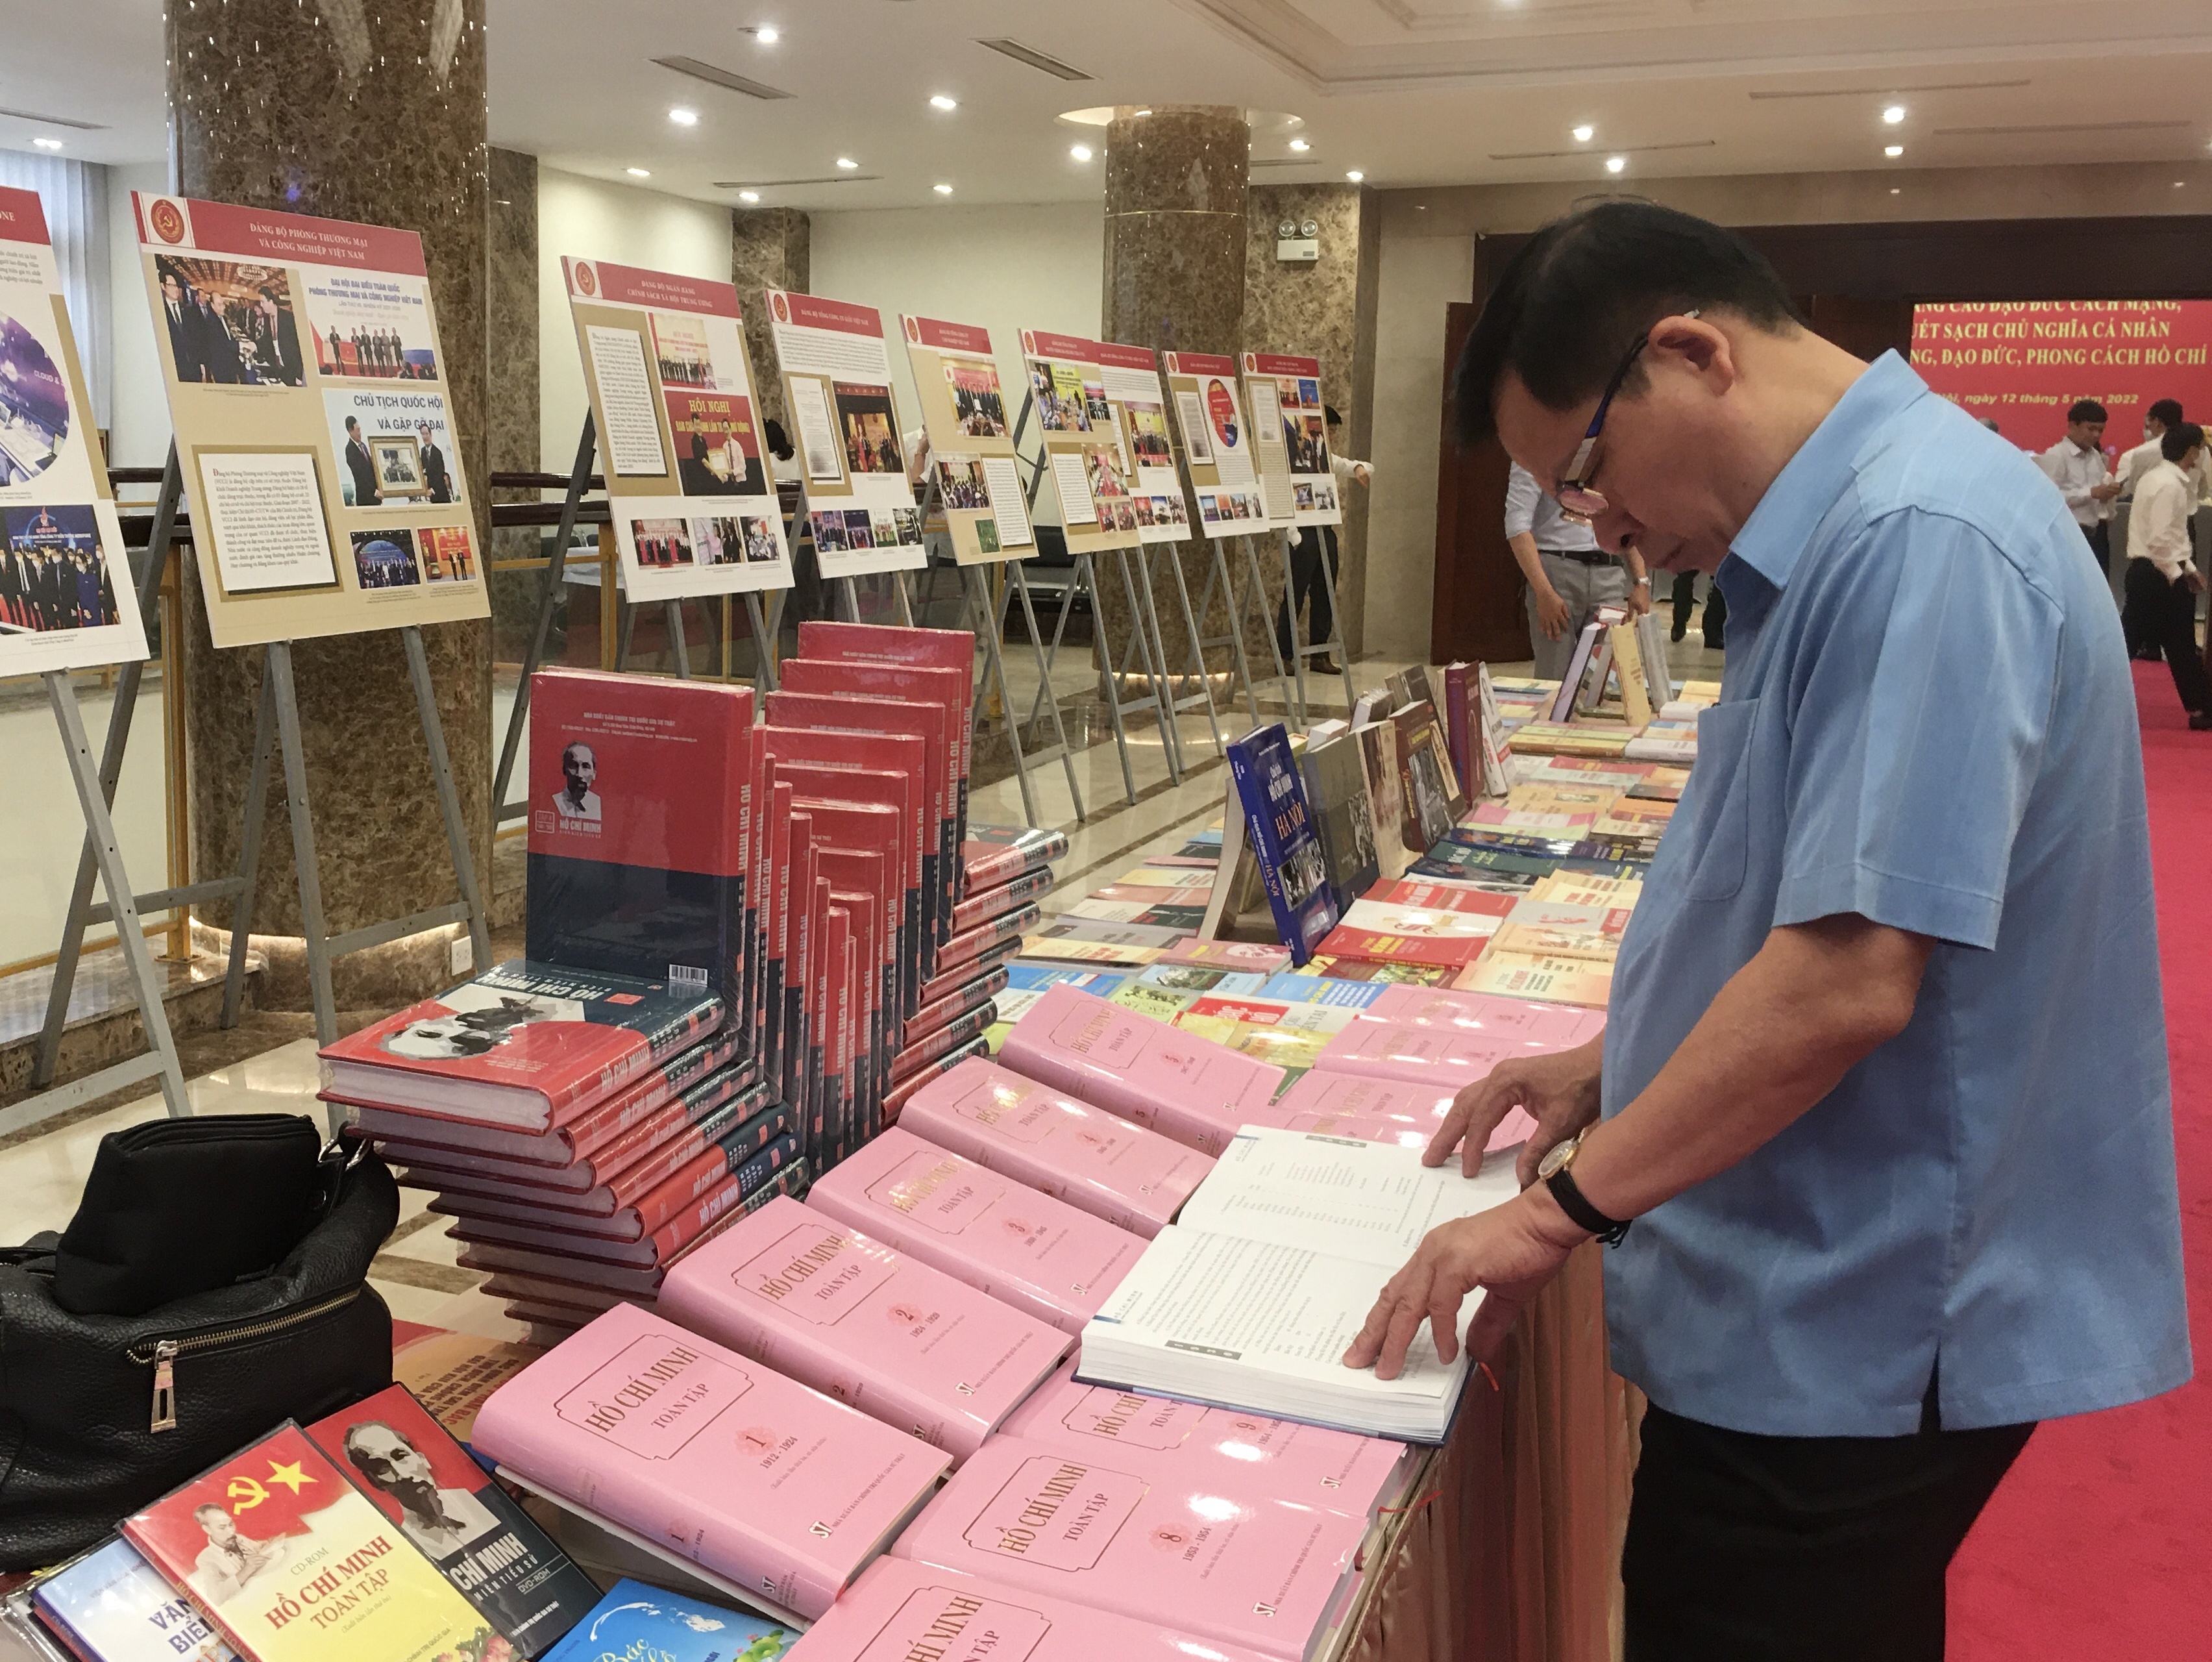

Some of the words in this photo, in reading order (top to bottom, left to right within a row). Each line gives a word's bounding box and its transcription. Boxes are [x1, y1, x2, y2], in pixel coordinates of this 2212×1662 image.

[250, 221, 273, 234] ĐẢNG
[276, 226, 287, 238] BỘ
[289, 228, 317, 240] PHÒNG
[353, 238, 368, 247] MẠI
[259, 238, 270, 247] VÀ
[272, 239, 295, 251] CÔNG
[297, 243, 326, 256] NGHIỆP
[328, 247, 345, 257] VIỆT
[348, 251, 365, 260] NAM
[1943, 323, 1988, 342] SẠCH
[1993, 318, 2028, 338] CHỦ
[2033, 318, 2088, 338] NGHĨA
[2092, 318, 2115, 338] CÁ
[2120, 317, 2170, 338] NHÂN
[1941, 349, 1977, 368] ĐẠO
[1981, 344, 2022, 367] ĐỨC,
[2026, 349, 2086, 365] PHONG
[2091, 344, 2139, 365] CÁCH
[2144, 343, 2170, 365] HỒ
[2174, 343, 2207, 365] CHÍ
[34, 370, 53, 383] CLOUD
[354, 393, 374, 406] CHỦ
[376, 396, 398, 410] TỊCH
[400, 394, 426, 408] QUỐC
[428, 395, 443, 410] HỘI
[689, 397, 706, 416] HỘI
[708, 400, 730, 416] NGHỊ
[1965, 395, 1997, 404] ngày
[2002, 394, 2017, 403] 12
[2020, 394, 2057, 405] tháng
[2061, 395, 2070, 403] 5
[2107, 395, 2138, 404] 2022
[377, 416, 391, 430] VÀ
[393, 417, 412, 432] GẶP
[429, 419, 444, 432] ĐẠI
[583, 822, 601, 833] MINH
[1275, 806, 1292, 840] HÀ
[1288, 799, 1306, 830] NỘI
[1136, 1110, 1146, 1118] 5
[699, 1199, 709, 1227] HỒ
[709, 1192, 721, 1219] CHÍ
[721, 1183, 739, 1209] MINH
[1009, 1222, 1026, 1233] 3
[758, 1274, 793, 1300] HỒ
[781, 1255, 819, 1284] CHÍ
[804, 1235, 845, 1269] MINH
[814, 1278, 846, 1300] TOÀN
[841, 1265, 862, 1285] TẬP
[895, 1309, 915, 1321] 2
[584, 1400, 626, 1433] HỒ
[614, 1374, 659, 1408] CHÍ
[641, 1346, 700, 1386] MINH
[832, 1384, 846, 1396] 2
[650, 1401, 689, 1429] TOÀN
[682, 1383, 709, 1403] TẬP
[1090, 1413, 1127, 1437] HỒ
[1111, 1391, 1148, 1418] CHÍ
[1149, 1405, 1175, 1428] TOÀN
[1236, 1421, 1257, 1432] 9
[746, 1435, 767, 1448] 1
[759, 1453, 780, 1469] 1912
[779, 1435, 798, 1451] 1924
[1038, 1464, 1088, 1503] MINH
[1018, 1497, 1059, 1527] CHÍ
[1063, 1513, 1095, 1541] TOÀN
[1085, 1493, 1109, 1513] TẬP
[808, 1520, 833, 1539] ST
[995, 1526, 1037, 1554] HỒ
[1159, 1532, 1182, 1543] 8
[1182, 1546, 1199, 1562] 1953
[1195, 1526, 1212, 1543] 1954
[290, 1547, 329, 1576] CD-ROM
[449, 1552, 488, 1591] CHÍ
[475, 1532, 528, 1574] MINH
[264, 1592, 302, 1630] HỒ
[299, 1566, 343, 1604] CHÍ
[335, 1535, 393, 1581] MINH
[474, 1580, 501, 1602] NIÊN
[518, 1569, 550, 1593] DVD-ROM
[310, 1589, 360, 1630] TOÀN
[356, 1569, 391, 1596] TẬP
[1251, 1601, 1278, 1618] ST
[923, 1596, 984, 1645] MINH
[972, 1630, 1000, 1655] TẬP
